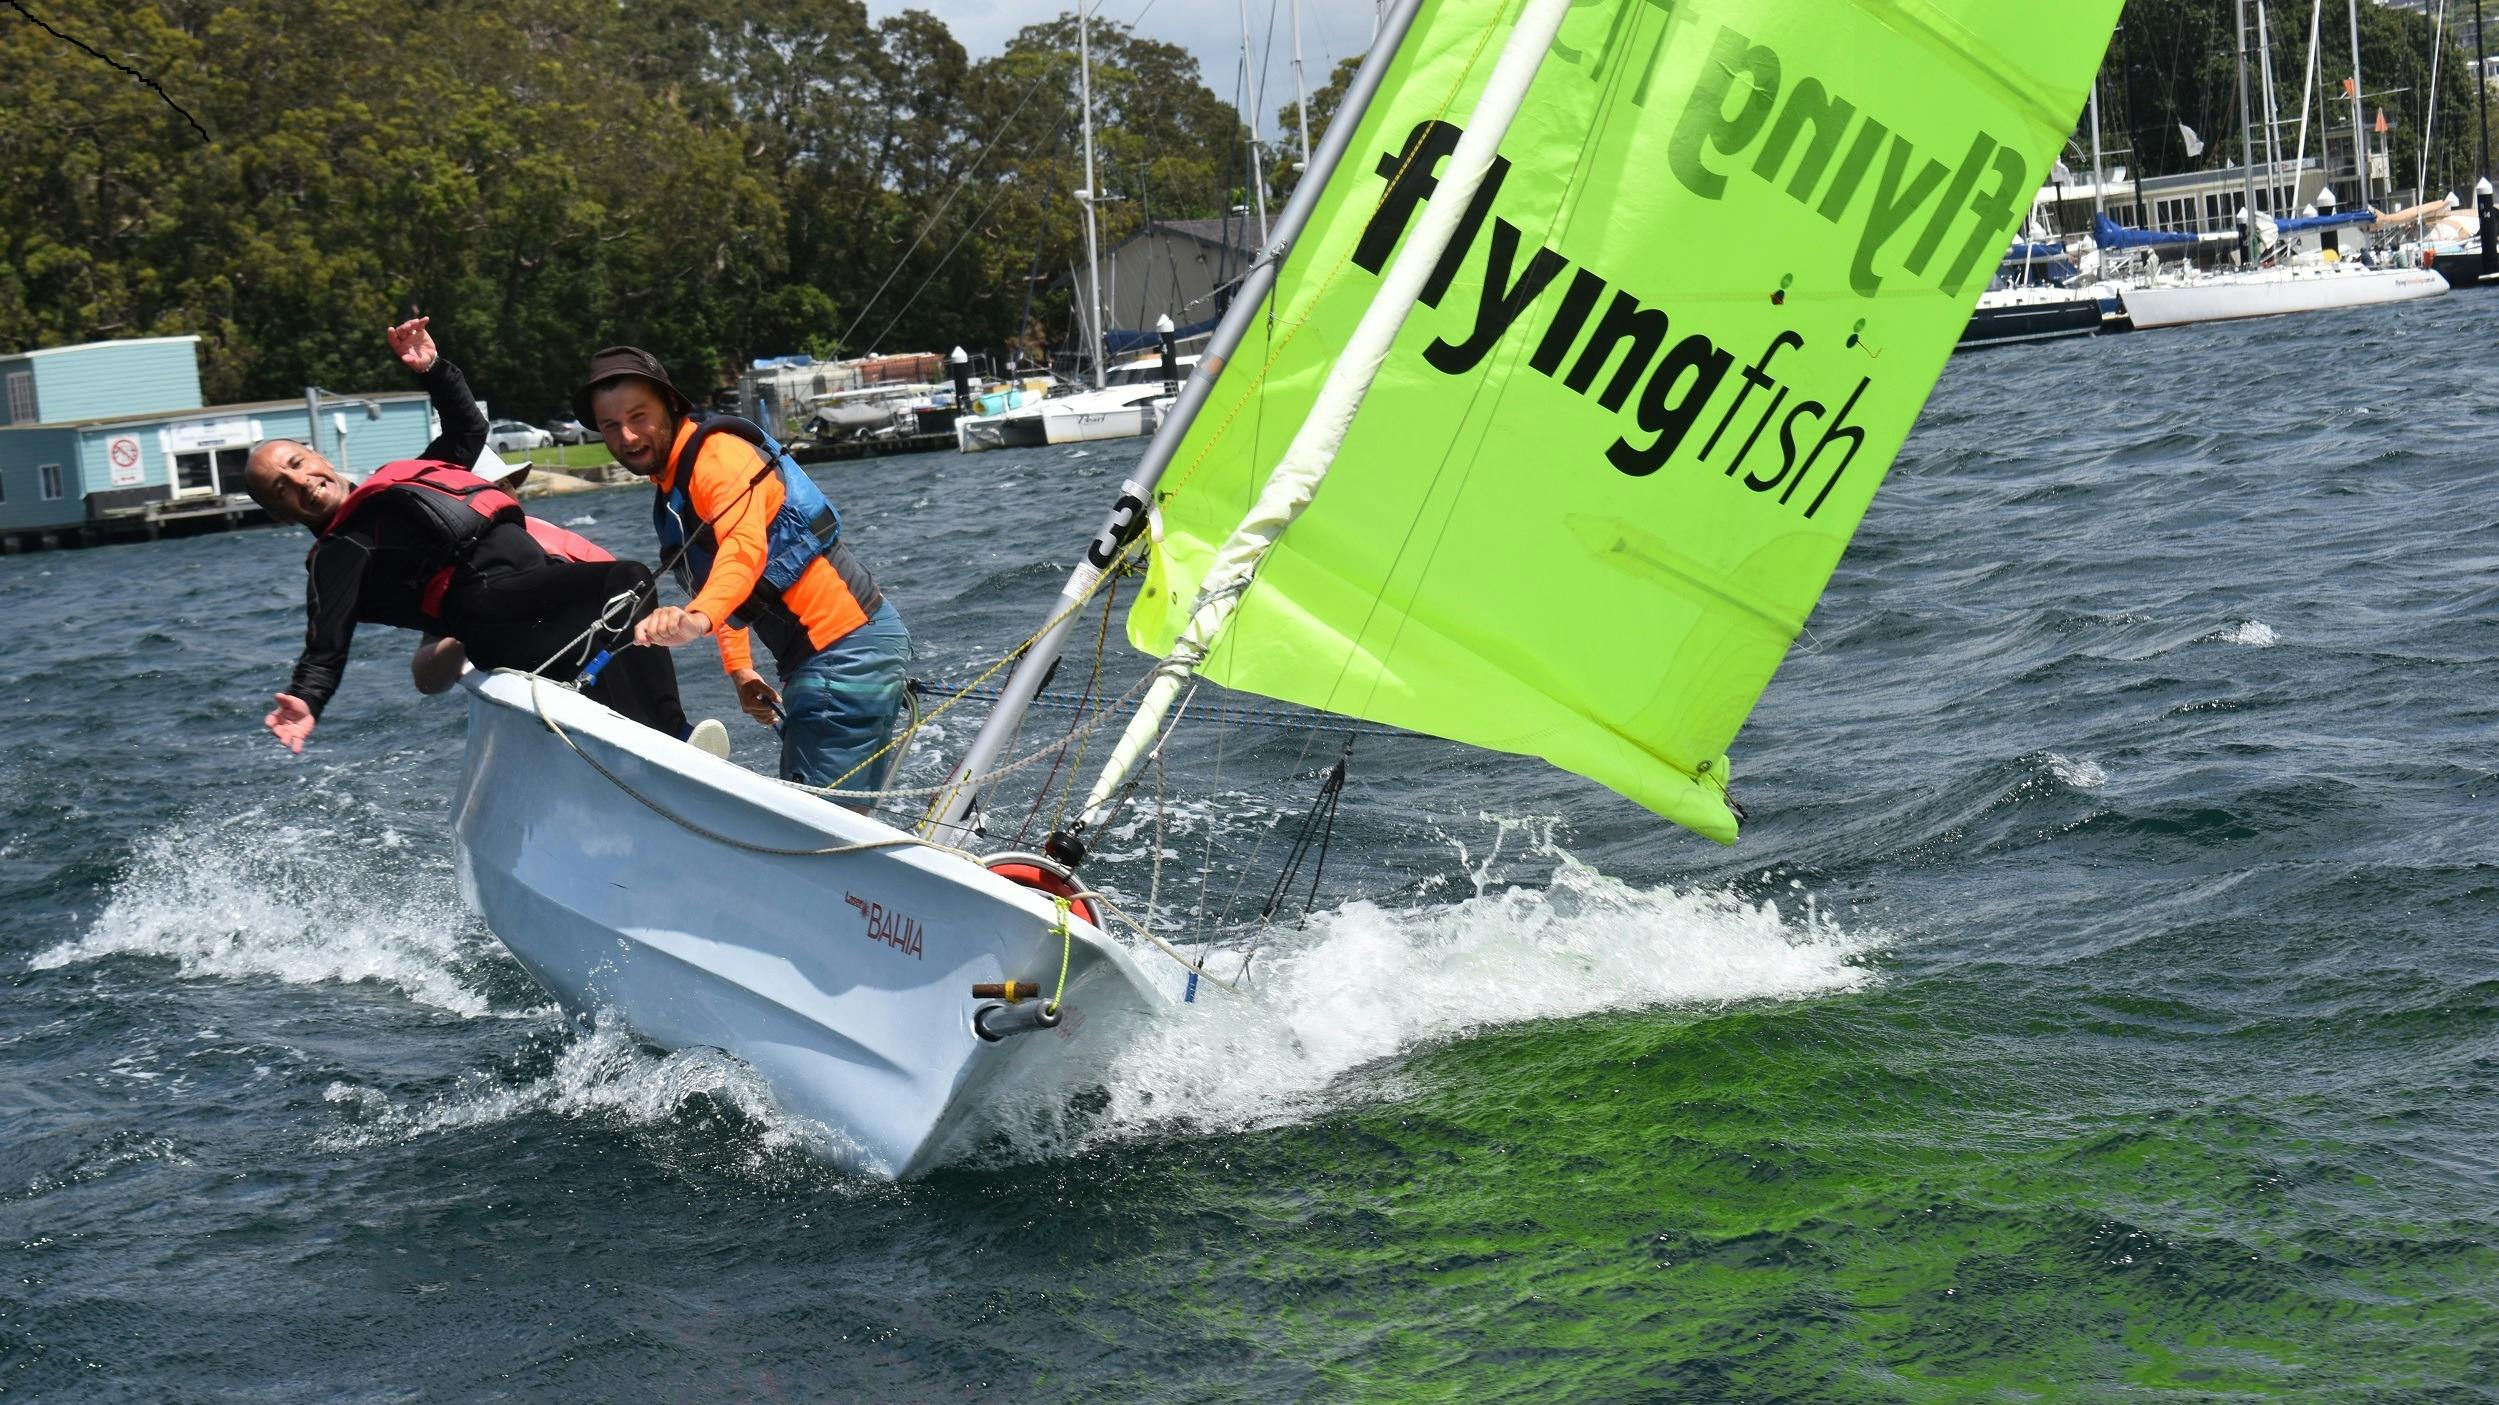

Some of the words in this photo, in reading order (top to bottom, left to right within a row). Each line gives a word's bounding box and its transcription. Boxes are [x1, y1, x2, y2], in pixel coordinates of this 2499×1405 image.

[1352, 119, 1869, 519] flyingfish
[1088, 496, 1142, 569] 3
[867, 902, 922, 960] BAHIA
